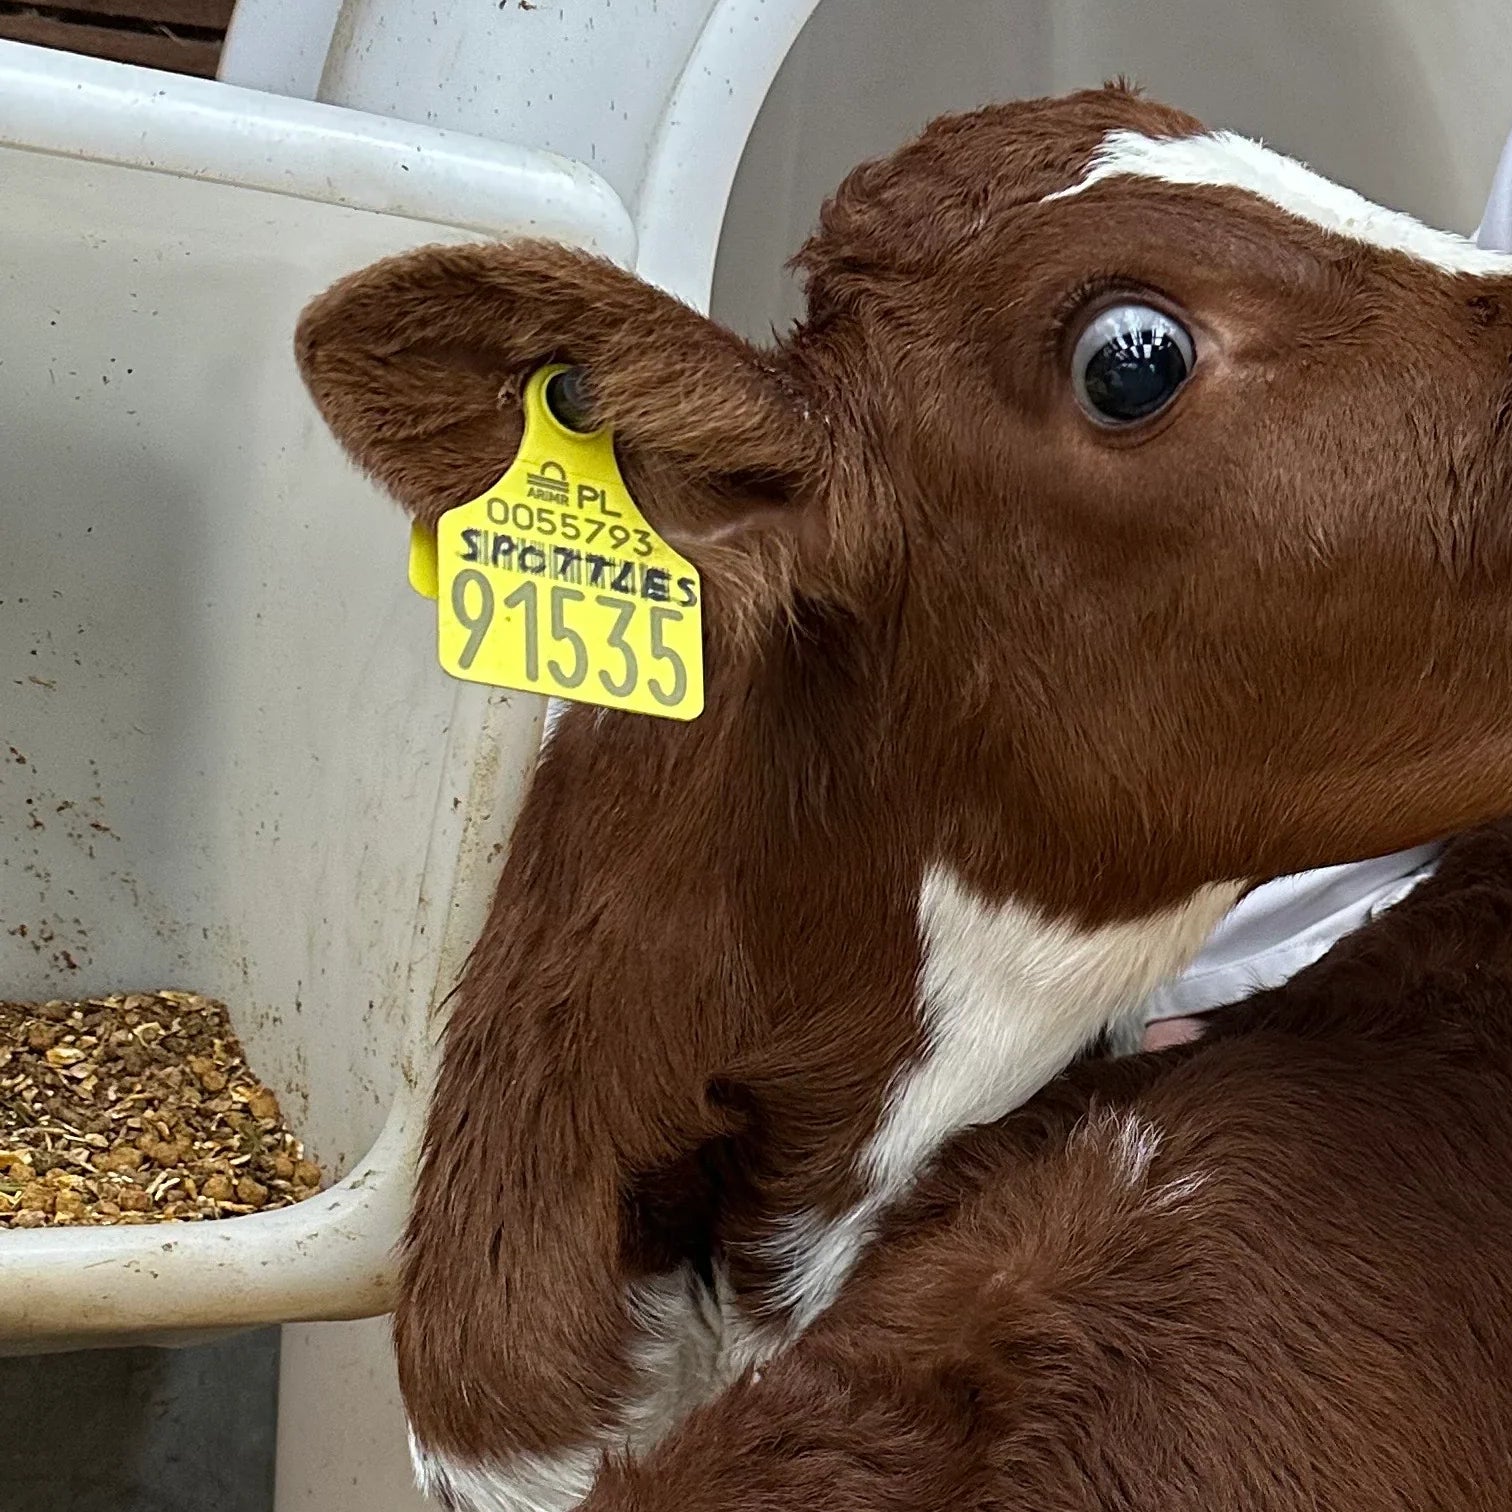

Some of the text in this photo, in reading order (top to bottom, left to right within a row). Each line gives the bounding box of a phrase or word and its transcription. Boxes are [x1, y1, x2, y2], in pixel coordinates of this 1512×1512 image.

[486, 497, 654, 557] 0055793
[577, 484, 623, 518] PL
[451, 568, 688, 706] 91535
